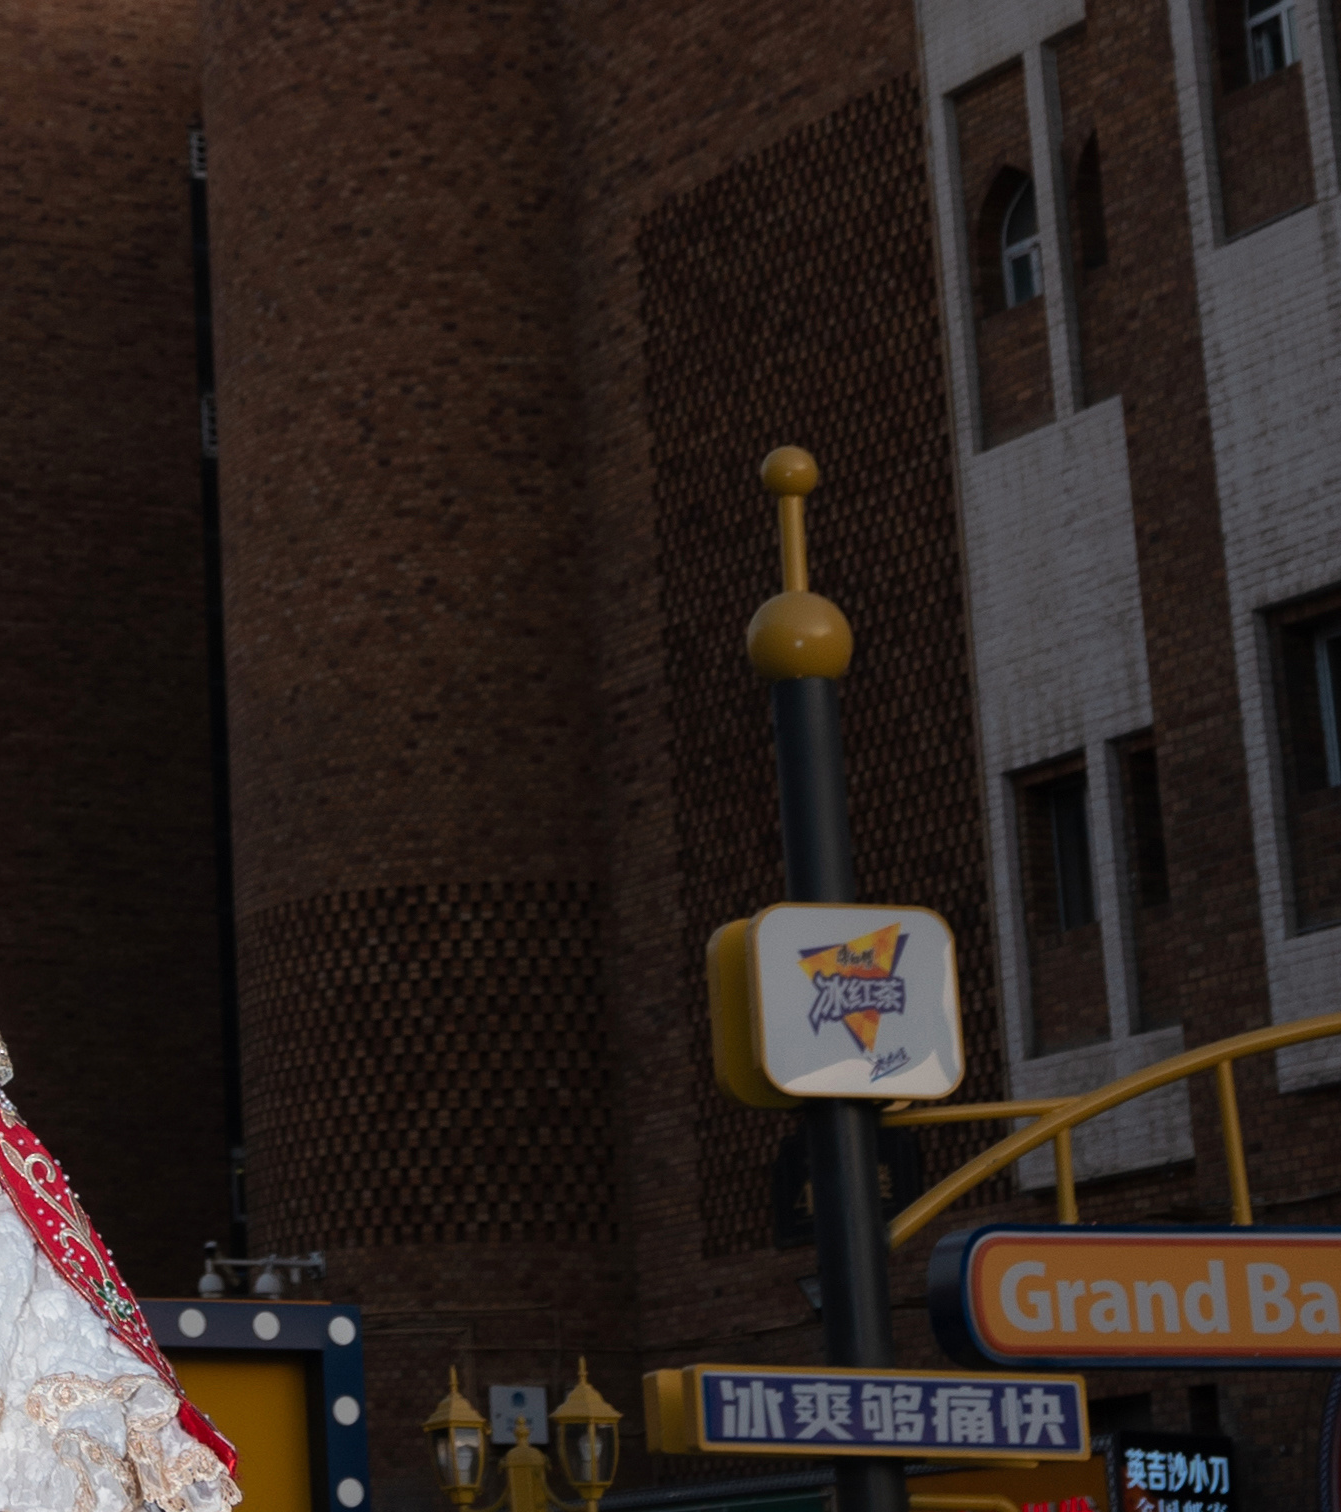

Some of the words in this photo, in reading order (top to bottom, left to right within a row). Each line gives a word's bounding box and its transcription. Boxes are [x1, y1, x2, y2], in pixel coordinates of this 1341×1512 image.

[809, 972, 905, 1028] 冰红茶
[999, 1260, 1231, 1334] Grand
[719, 1379, 1066, 1446] 冰爽够痛快
[1123, 1447, 1231, 1495] 英吉沙小刀
